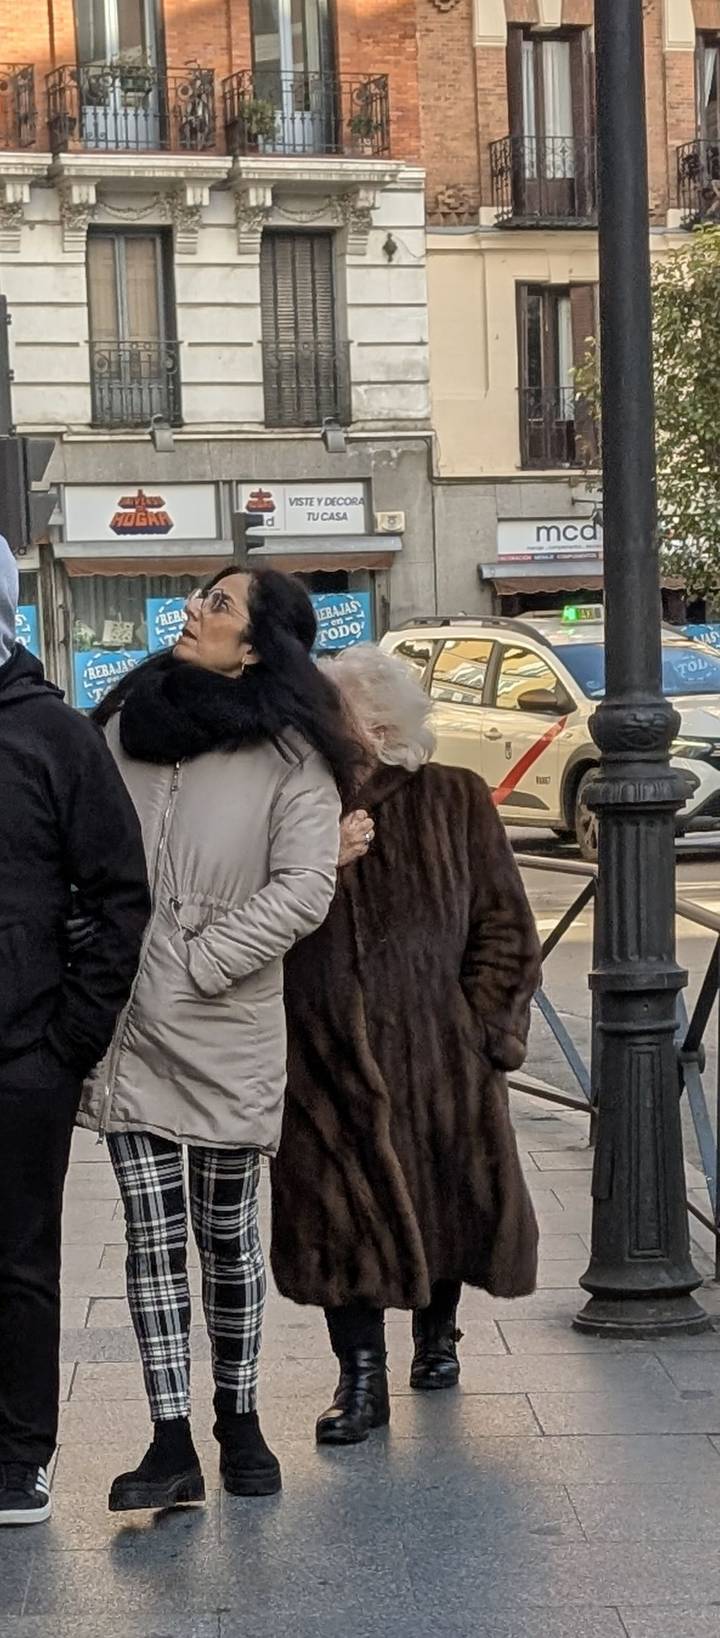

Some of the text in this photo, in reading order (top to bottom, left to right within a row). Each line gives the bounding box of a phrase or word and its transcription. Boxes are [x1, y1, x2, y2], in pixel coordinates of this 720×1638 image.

[288, 496, 365, 507] VISTE Y DECORA
[307, 512, 348, 521] TU CASA
[536, 523, 597, 542] mcd
[319, 622, 361, 642] TODO
[88, 659, 135, 680] REBAJAS
